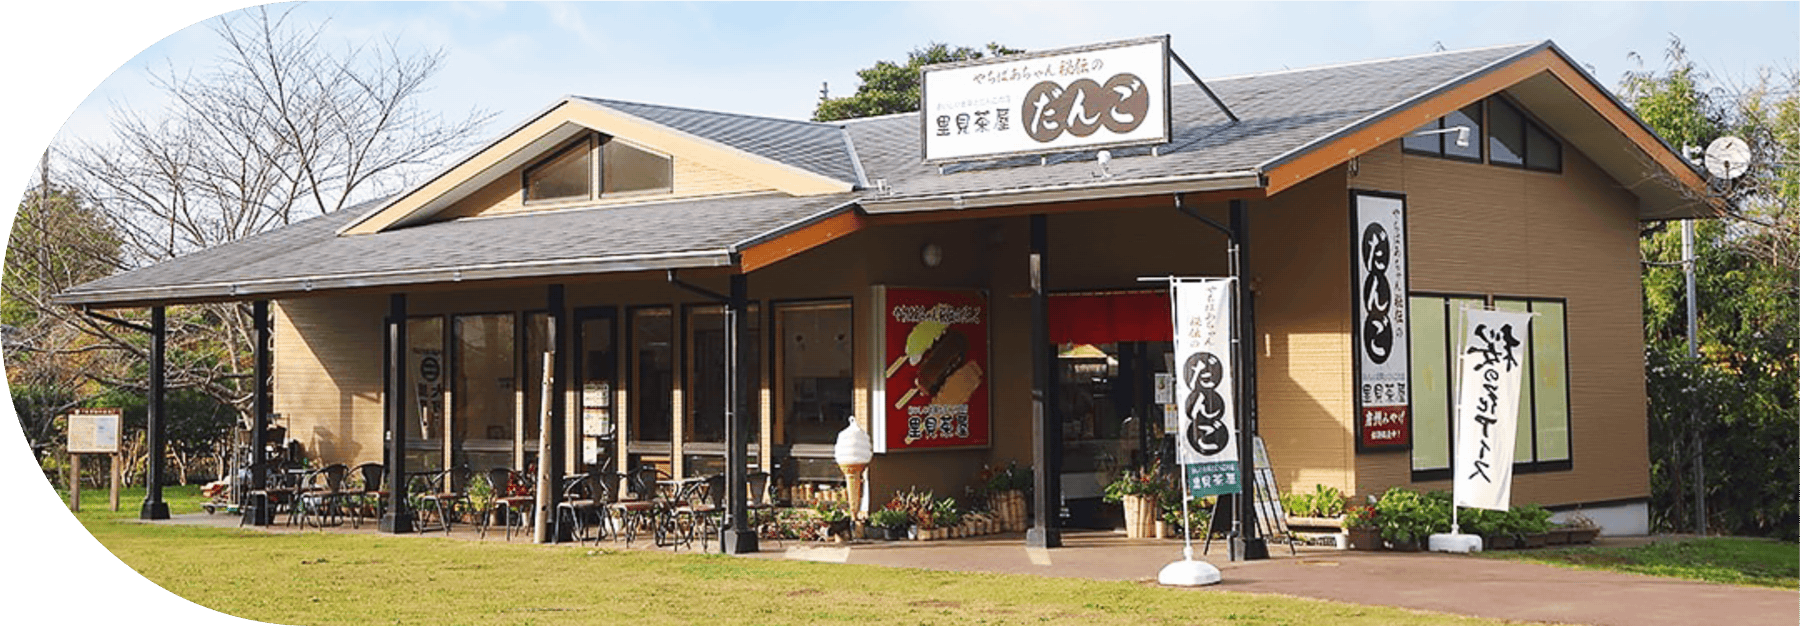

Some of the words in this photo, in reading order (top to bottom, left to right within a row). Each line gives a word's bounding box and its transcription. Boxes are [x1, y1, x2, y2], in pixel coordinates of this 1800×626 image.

[936, 108, 1010, 136] 里見茶屋
[1031, 78, 1141, 135] だんご
[1366, 229, 1390, 357] だんご
[1189, 355, 1223, 451] だんご
[1363, 383, 1406, 403] 里見茶屋
[907, 414, 969, 439] 里見茶屋
